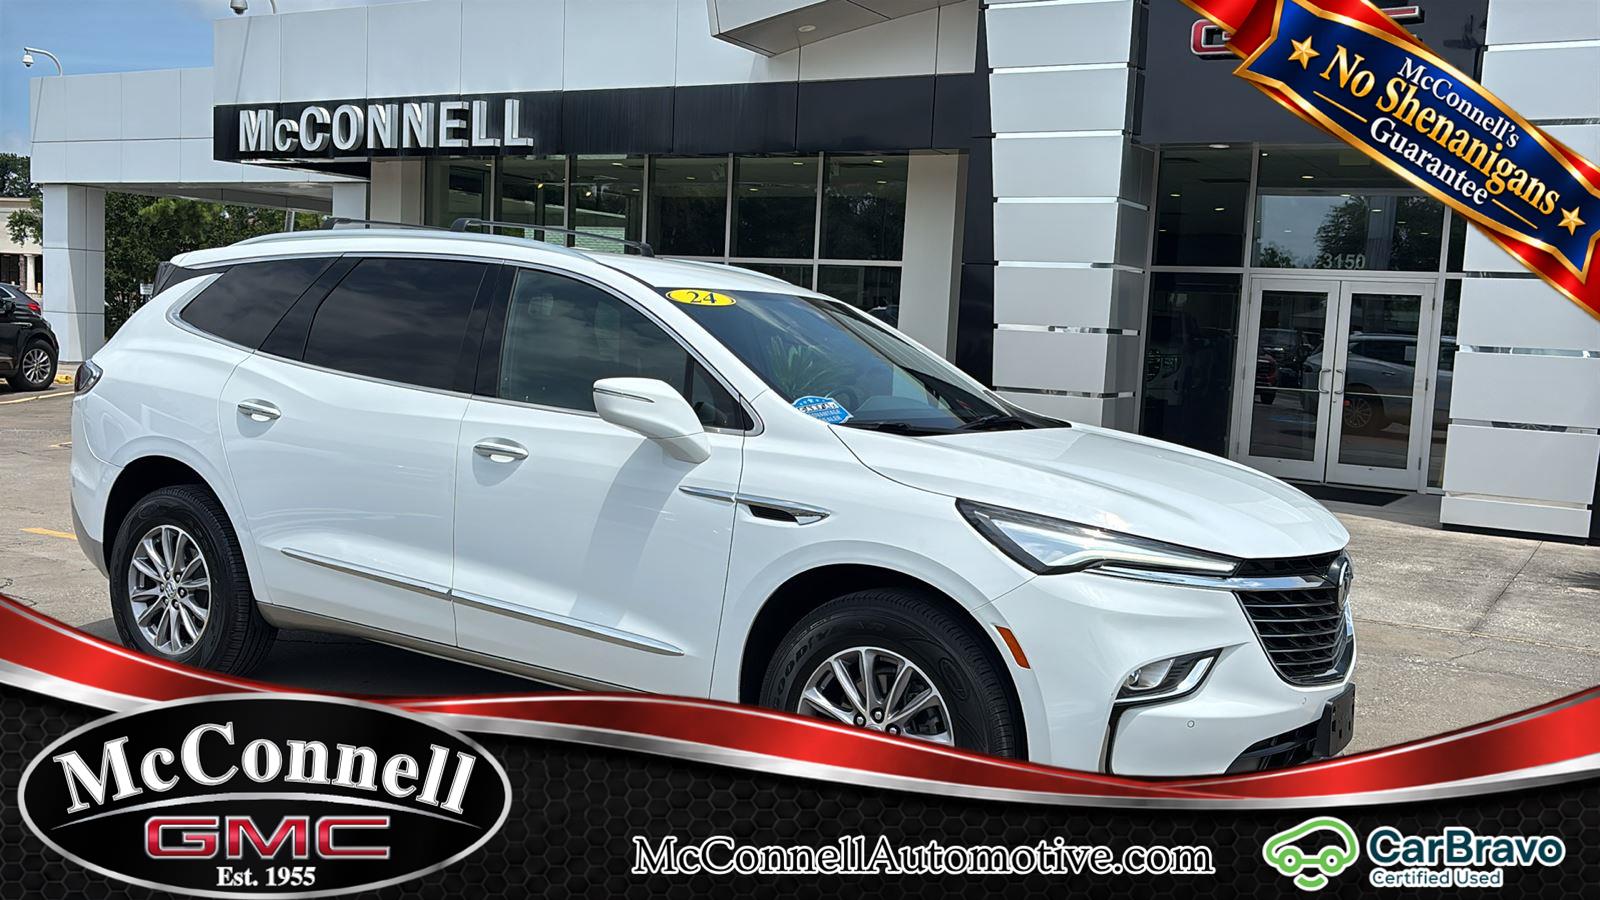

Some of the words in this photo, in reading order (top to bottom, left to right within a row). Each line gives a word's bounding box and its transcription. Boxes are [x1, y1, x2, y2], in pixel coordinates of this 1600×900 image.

[239, 98, 534, 152] McCONNELL
[1322, 253, 1366, 269] 3150
[686, 291, 716, 304] 24
